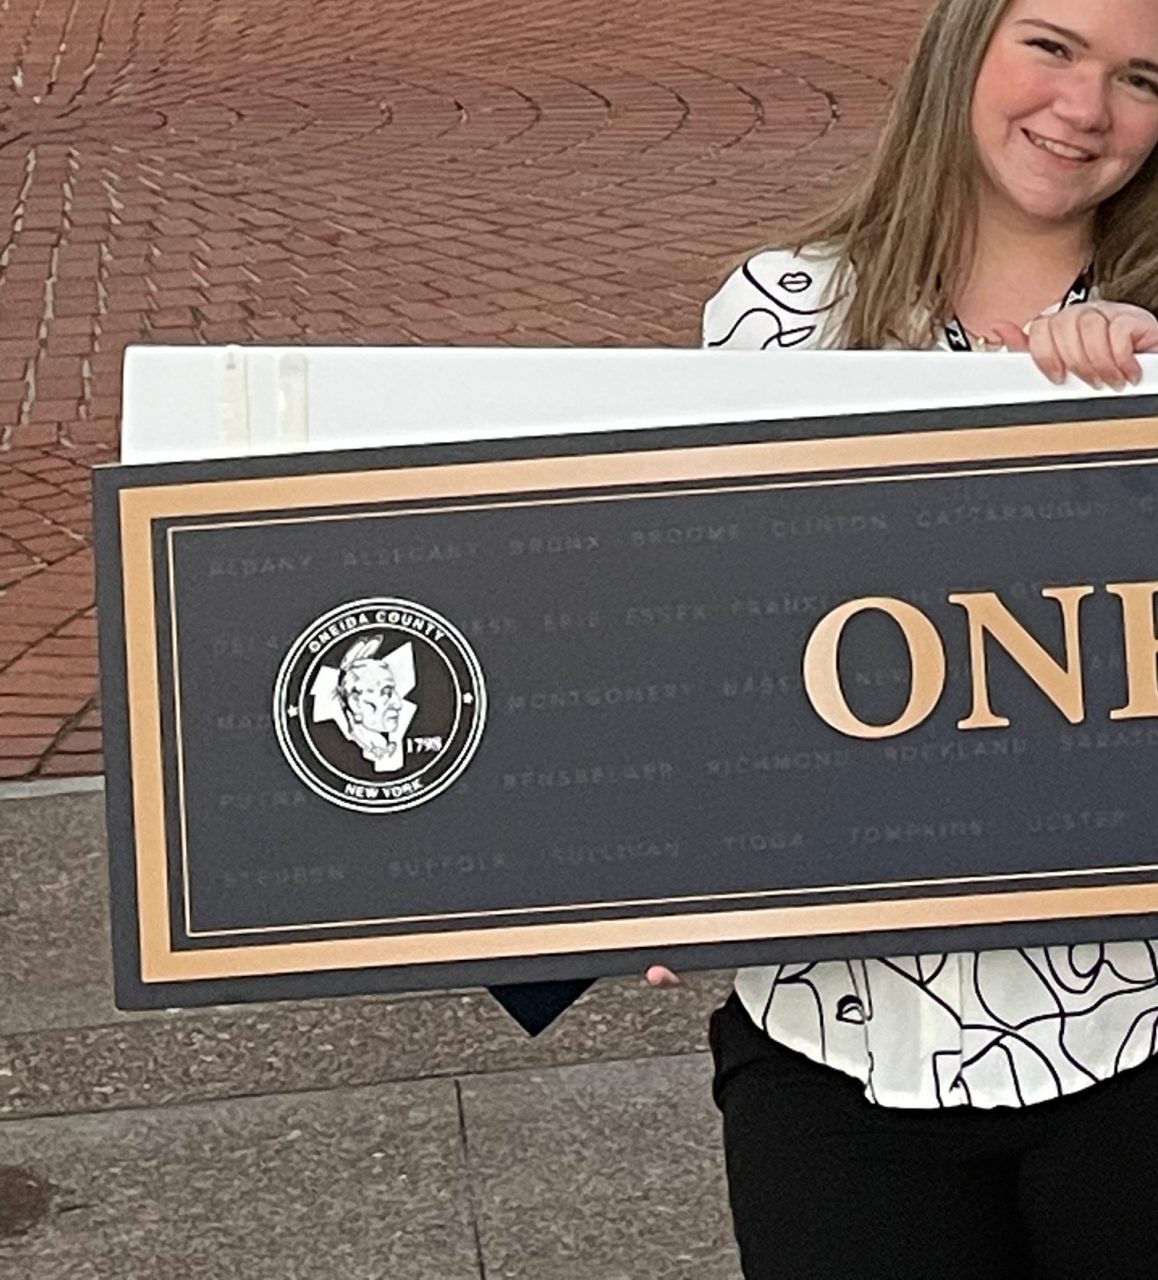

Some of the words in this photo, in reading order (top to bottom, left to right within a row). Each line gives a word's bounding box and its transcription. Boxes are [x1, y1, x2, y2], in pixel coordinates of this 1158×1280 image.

[308, 612, 370, 653] ONEIDA
[375, 610, 445, 642] COUNTY
[344, 783, 379, 799] NEW
[381, 778, 424, 798] YORK
